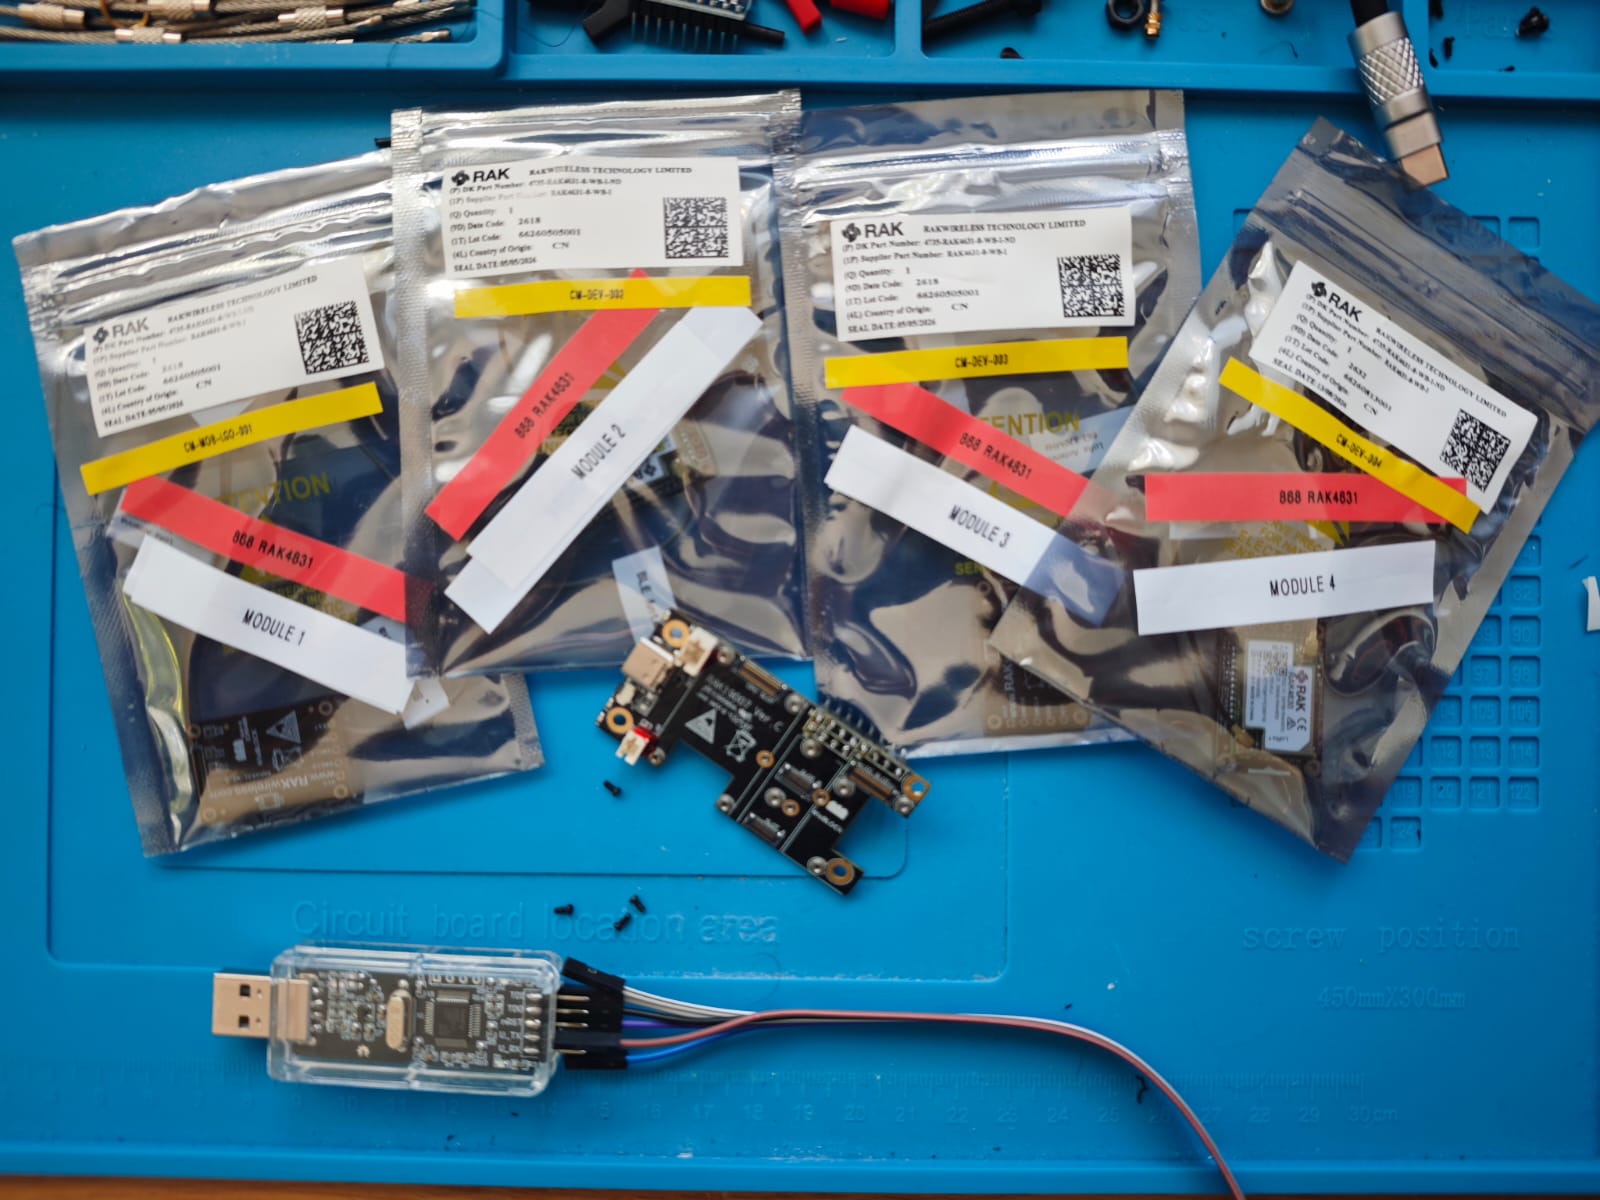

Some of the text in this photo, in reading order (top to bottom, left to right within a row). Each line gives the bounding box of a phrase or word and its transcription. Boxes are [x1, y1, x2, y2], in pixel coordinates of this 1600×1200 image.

[472, 168, 510, 182] RAK
[529, 165, 691, 175] RAKWIRELESS TECHNOLOGY LIMITED
[864, 221, 904, 238] RAK
[923, 219, 1085, 233] RAKWIRELESS TECHNOLOGY LIMITED
[469, 248, 496, 257] Country
[507, 244, 532, 253] Origin:
[889, 239, 920, 247] Number:
[453, 264, 474, 272] SEAL
[860, 254, 891, 263] Supplier
[911, 250, 941, 259] Number:
[858, 268, 892, 278] Quantity:
[916, 278, 938, 286] 2618
[879, 294, 898, 302] Code:
[1326, 292, 1364, 322] RAK
[864, 308, 893, 318] Country
[905, 305, 930, 314] Origin:
[1327, 308, 1343, 321] Part
[1342, 318, 1369, 339] Number:
[1307, 321, 1338, 344] Quantity:
[1314, 312, 1342, 332] Supplier
[1341, 329, 1356, 342] Part
[1356, 340, 1383, 360] Number:
[1271, 356, 1293, 374] SEAL
[1300, 343, 1312, 354] Lot
[1311, 351, 1331, 367] Code:
[1305, 333, 1321, 347] Date
[1320, 343, 1339, 359] Code:
[1347, 362, 1368, 379] 2632
[1373, 327, 1508, 418] RAKWIRELESS TECHNOLOGY LIMITED
[1294, 354, 1321, 375] Country
[1320, 372, 1329, 381] of
[1327, 377, 1350, 395] Origin:
[1362, 402, 1379, 416] CN
[514, 372, 576, 438] 868 RAK4631
[571, 423, 626, 481] MODULE 2
[983, 444, 1032, 480] RAK4631
[1279, 490, 1359, 504] 868 RAK4631
[948, 504, 1011, 548] MODULE 3
[233, 530, 314, 570] 868 RAK4631
[1270, 574, 1336, 598] MODULE 4
[242, 608, 306, 646] MODULE 1
[1296, 685, 1308, 732] RAK CE
[291, 902, 409, 938] Circuit
[434, 902, 524, 940] board
[700, 914, 779, 944] area
[1242, 917, 1521, 954] screw position
[1318, 985, 1466, 1008] 450mmX300mm
